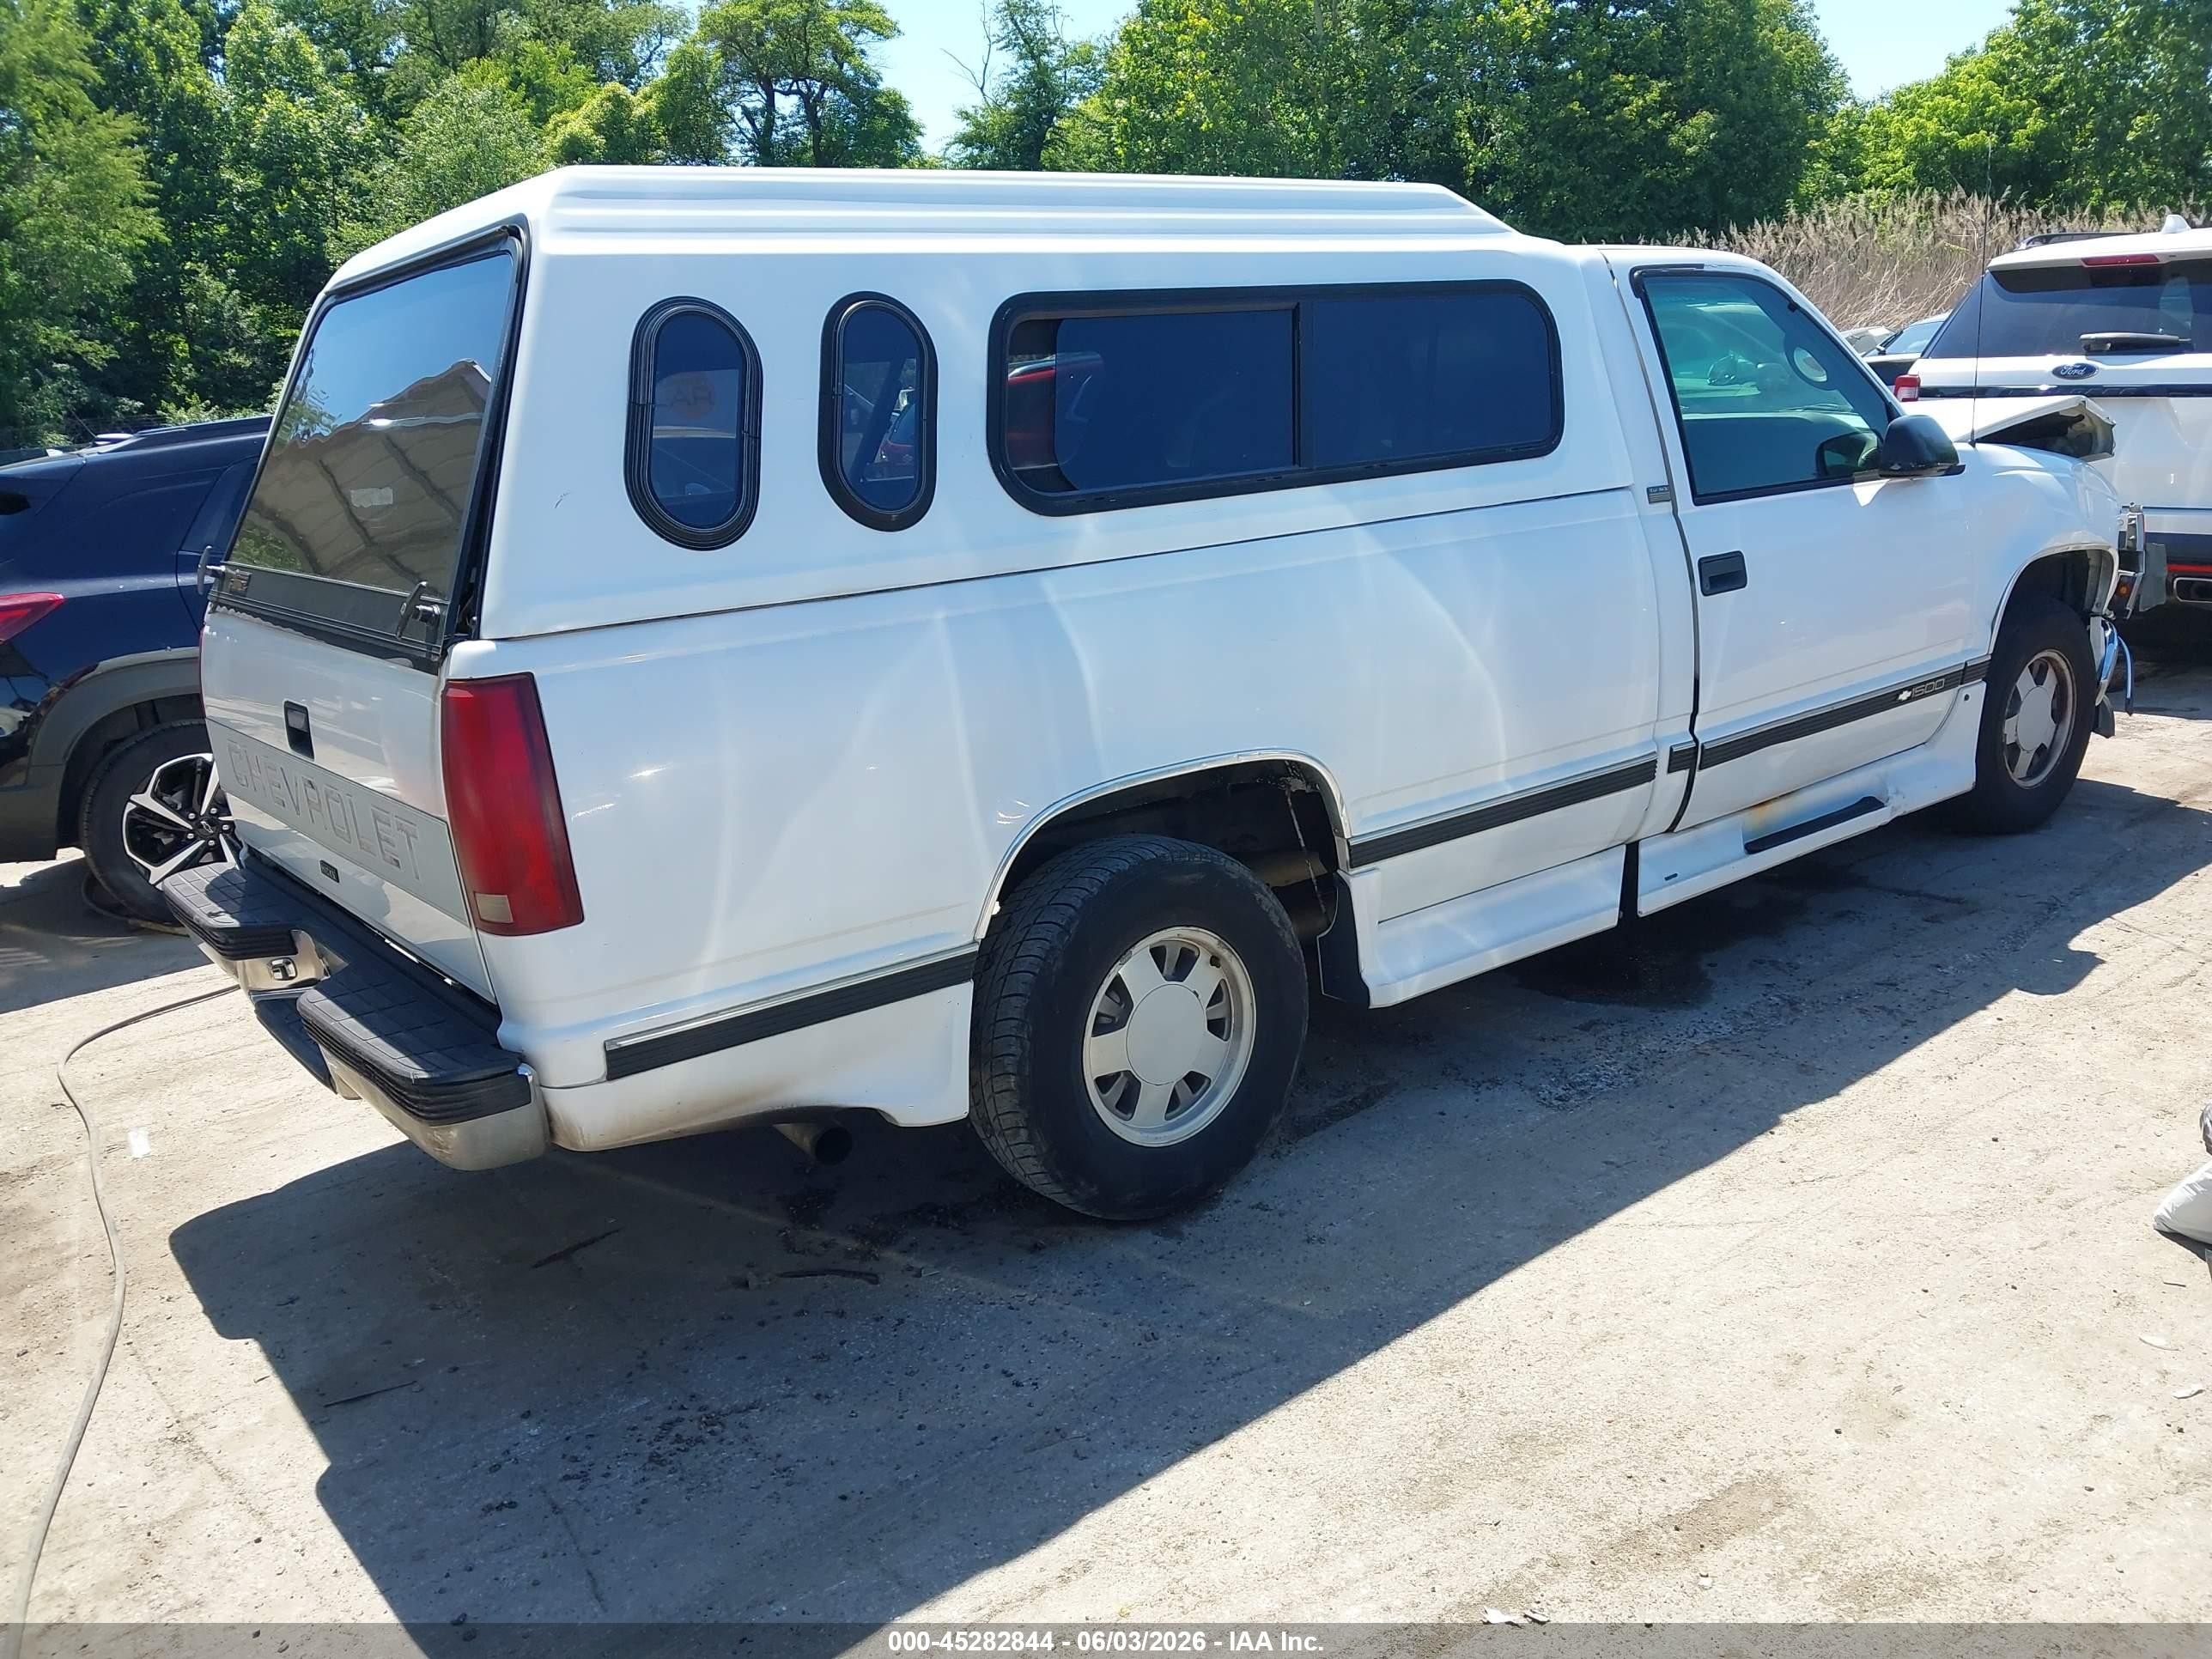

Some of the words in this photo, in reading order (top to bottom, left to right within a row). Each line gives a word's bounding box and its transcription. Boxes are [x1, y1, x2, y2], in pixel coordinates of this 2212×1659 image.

[2060, 365, 2087, 376] Ford
[1912, 678, 1945, 698] 1500
[228, 740, 420, 880] CHEVROLET
